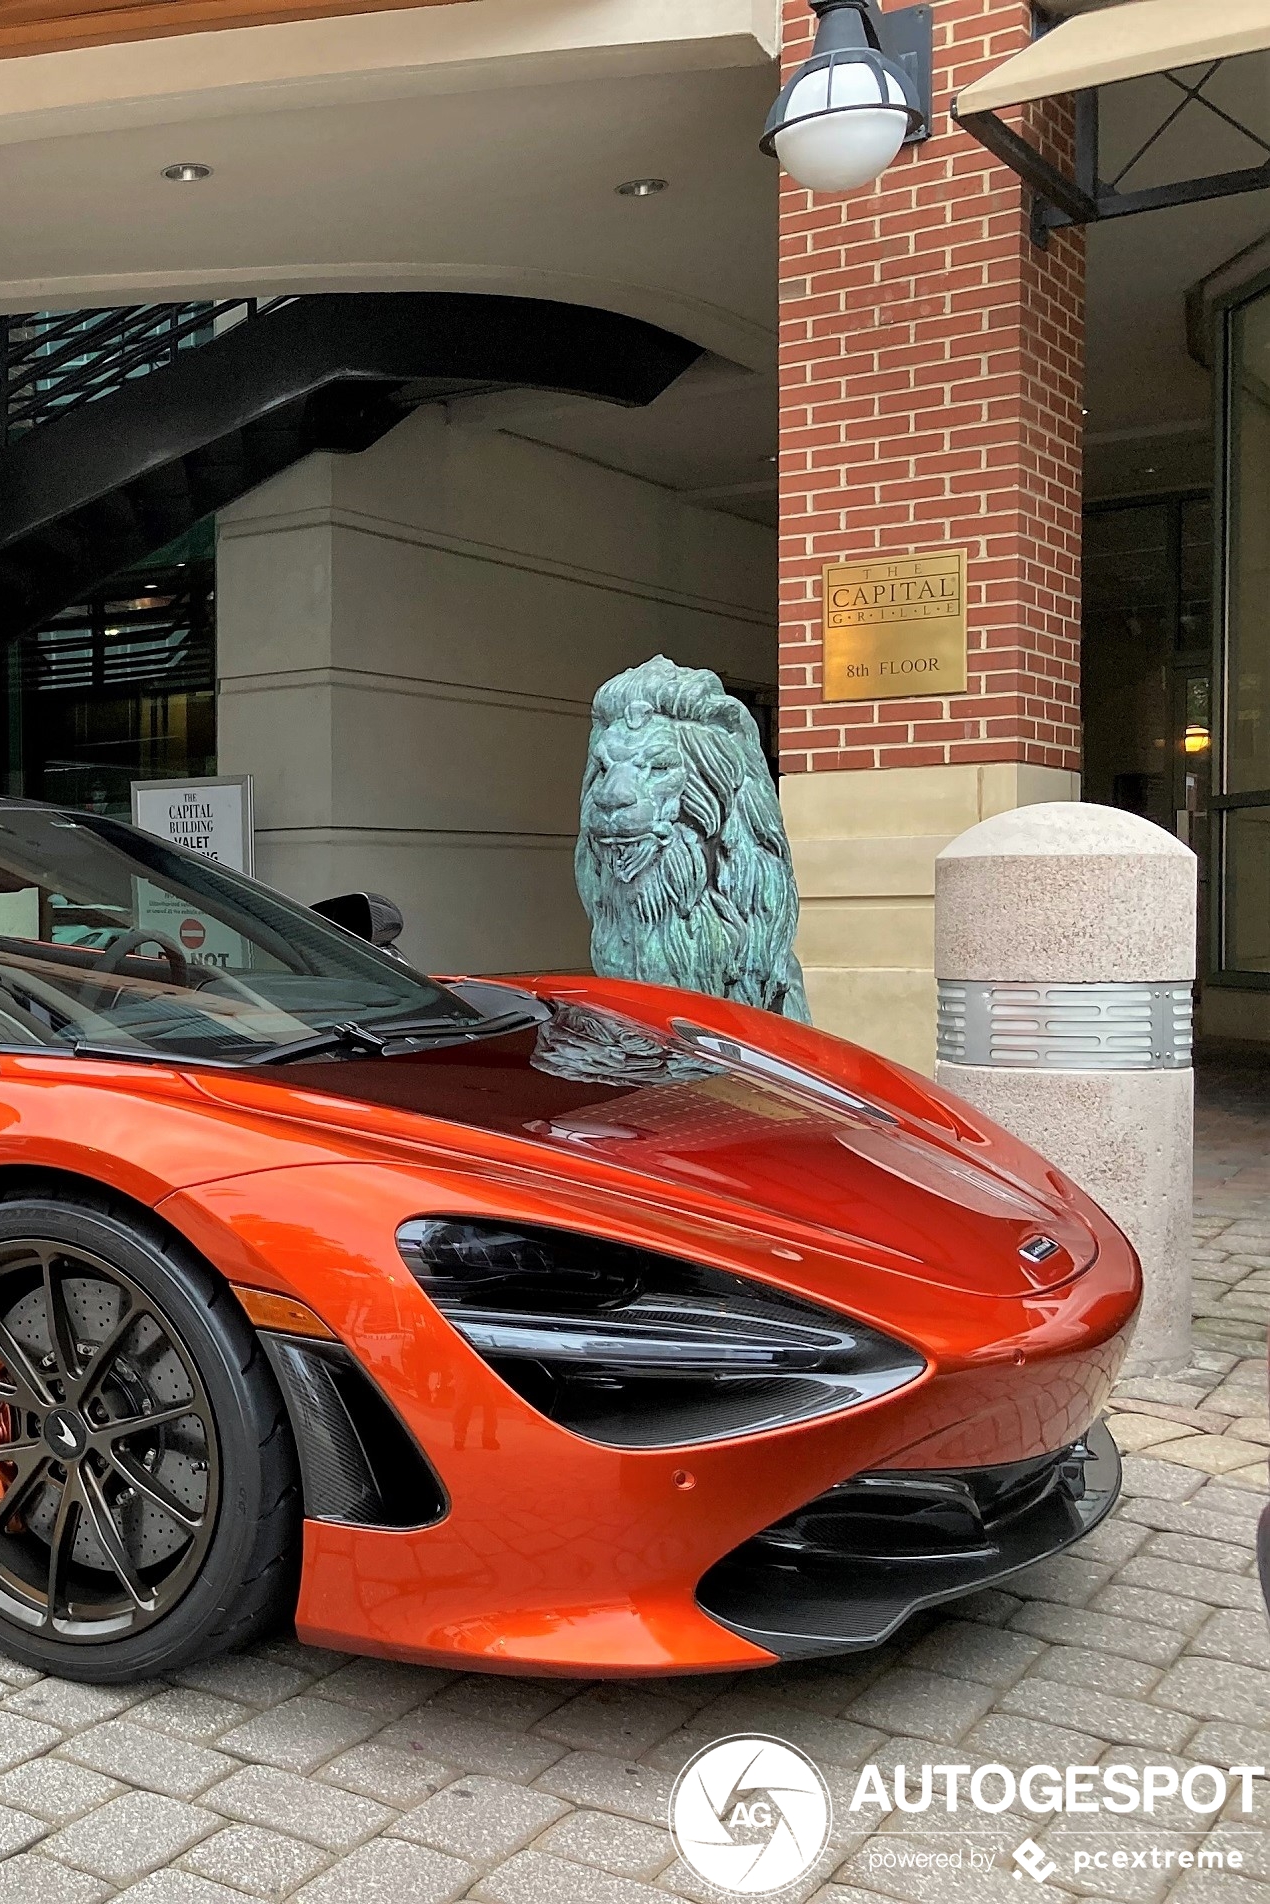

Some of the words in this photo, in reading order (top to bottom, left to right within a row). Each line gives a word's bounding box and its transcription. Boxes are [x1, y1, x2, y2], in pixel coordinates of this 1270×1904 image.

[863, 564, 922, 579] THE
[833, 579, 954, 608] CAPITAL
[846, 664, 869, 678] 8th
[879, 658, 940, 675] FLOOR
[184, 793, 197, 802] THE
[169, 804, 213, 819] CAPITAL
[169, 820, 213, 833] BUILDING
[190, 952, 229, 967] NOT
